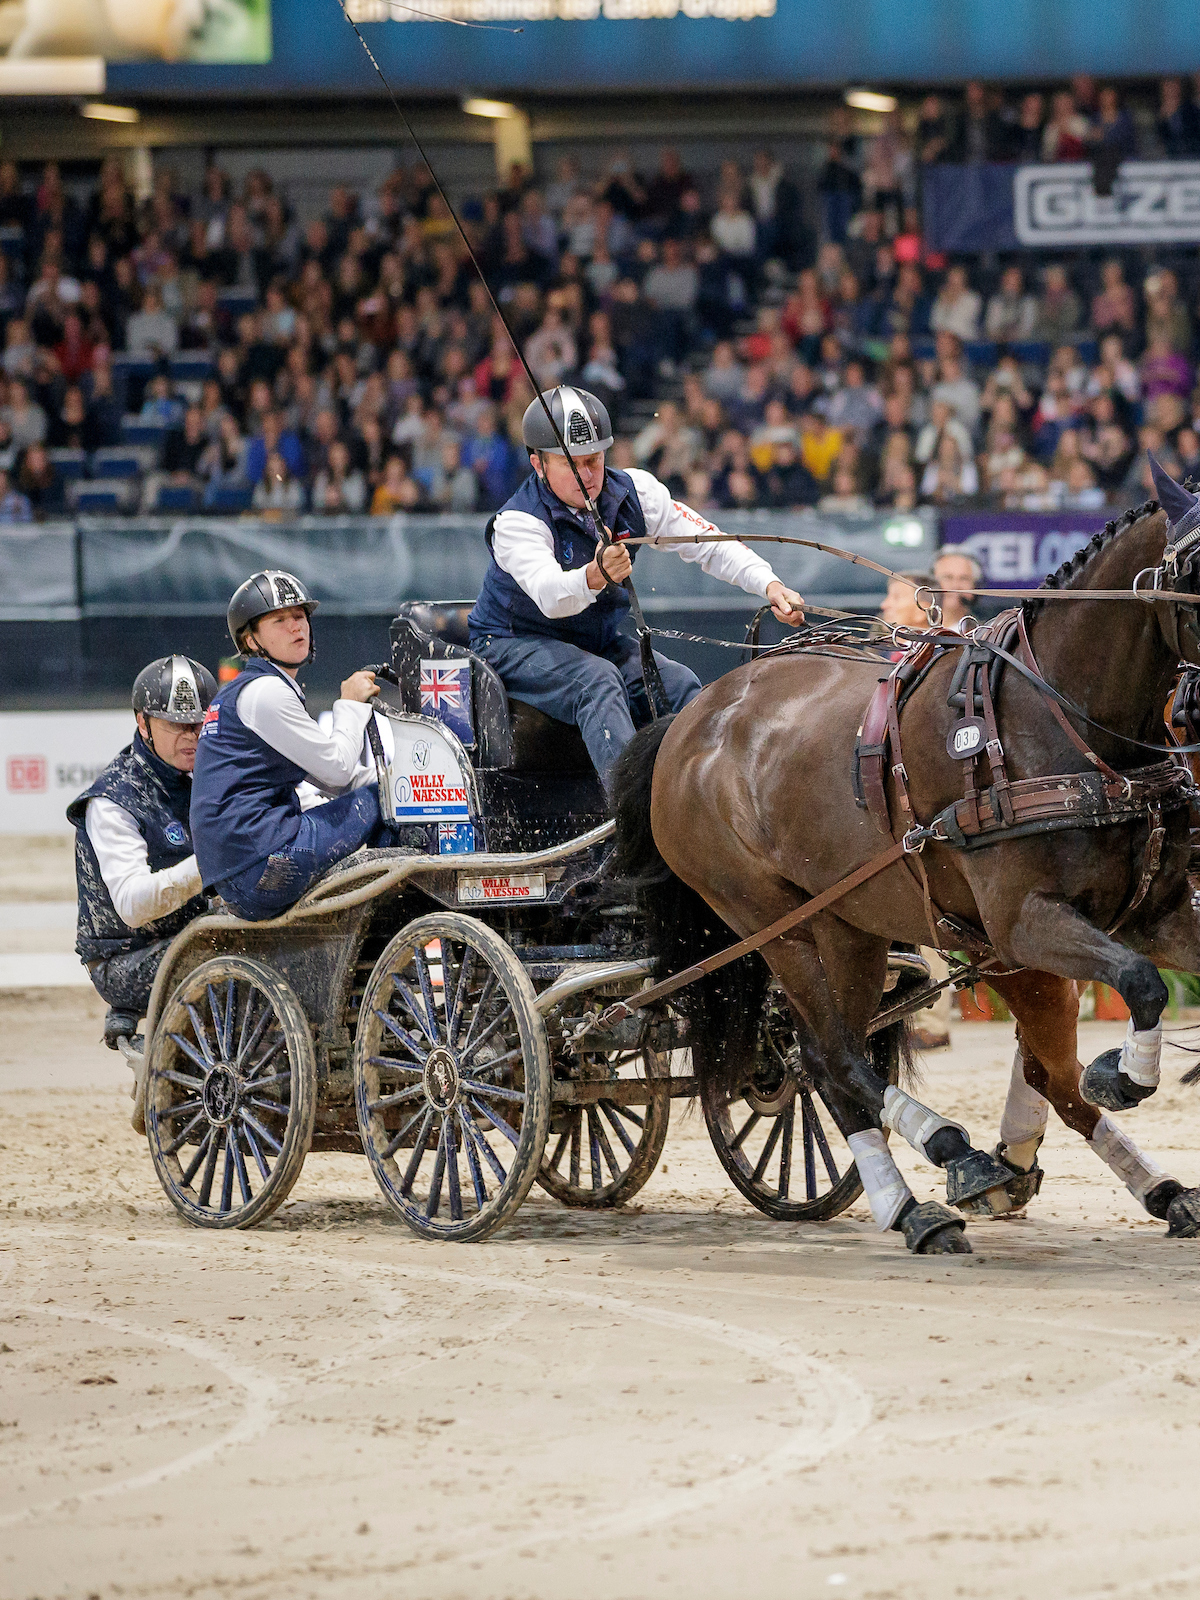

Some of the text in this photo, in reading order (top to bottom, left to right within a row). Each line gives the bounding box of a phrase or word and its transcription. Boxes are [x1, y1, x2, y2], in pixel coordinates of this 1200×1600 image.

[409, 775, 445, 788] WILLY
[413, 788, 467, 802] NAESSENS
[481, 878, 511, 888] WILLY
[483, 886, 530, 897] NAESSENS
